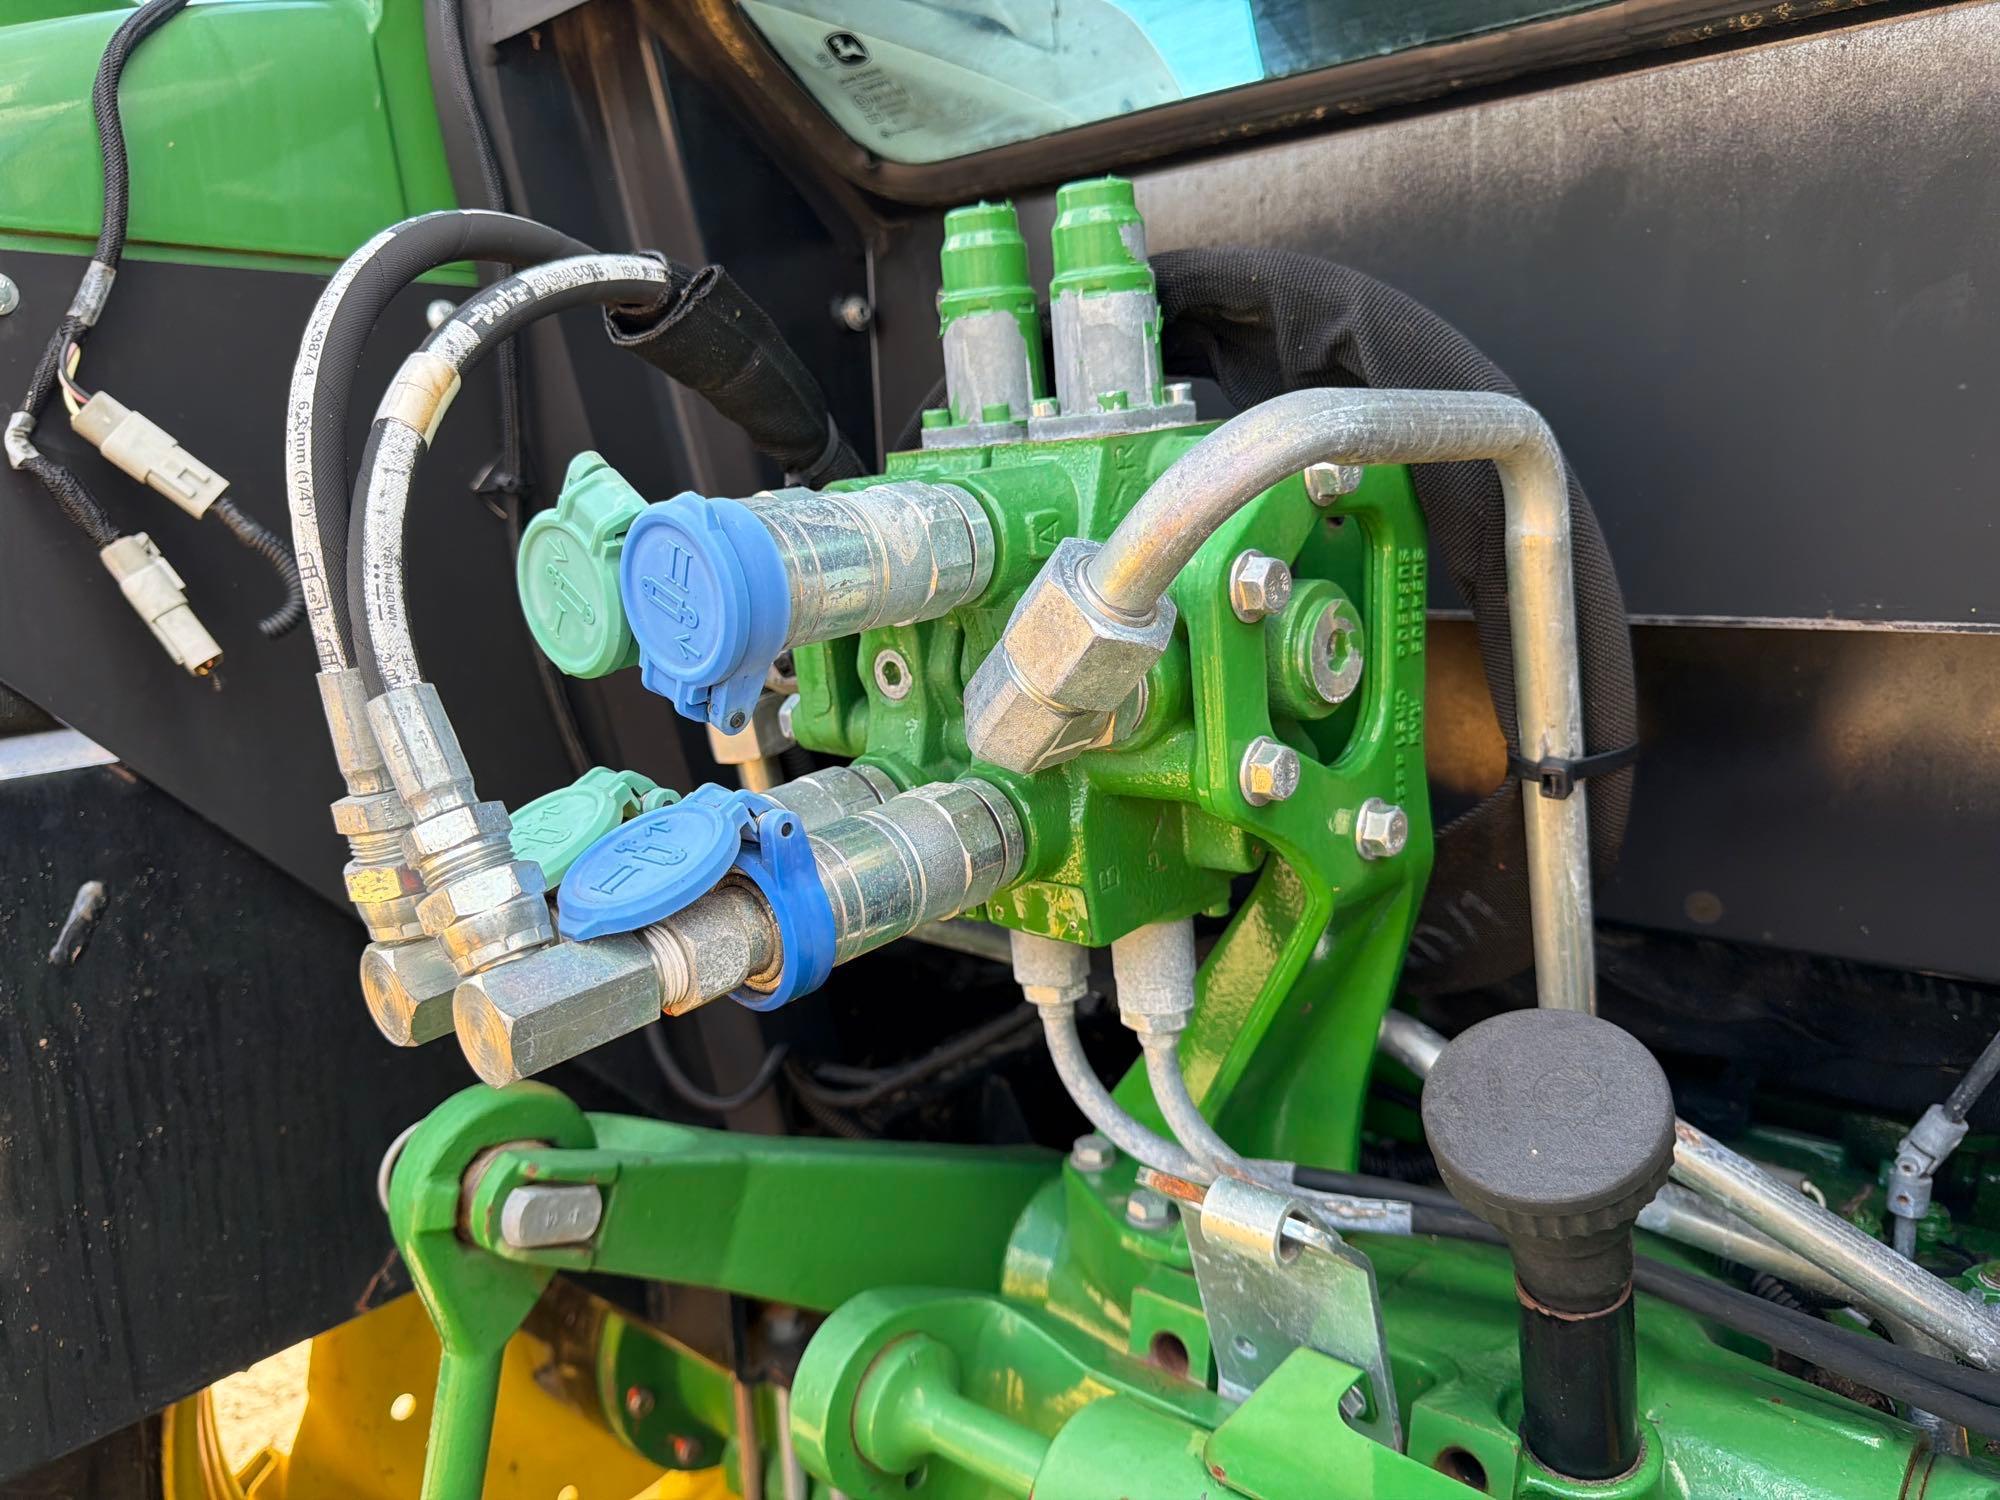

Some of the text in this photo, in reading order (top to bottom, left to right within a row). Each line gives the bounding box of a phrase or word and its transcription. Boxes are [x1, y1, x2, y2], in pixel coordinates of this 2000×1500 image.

[473, 281, 530, 325] Parker
[296, 432, 306, 463] mm
[383, 546, 398, 621] MADE IN USA
